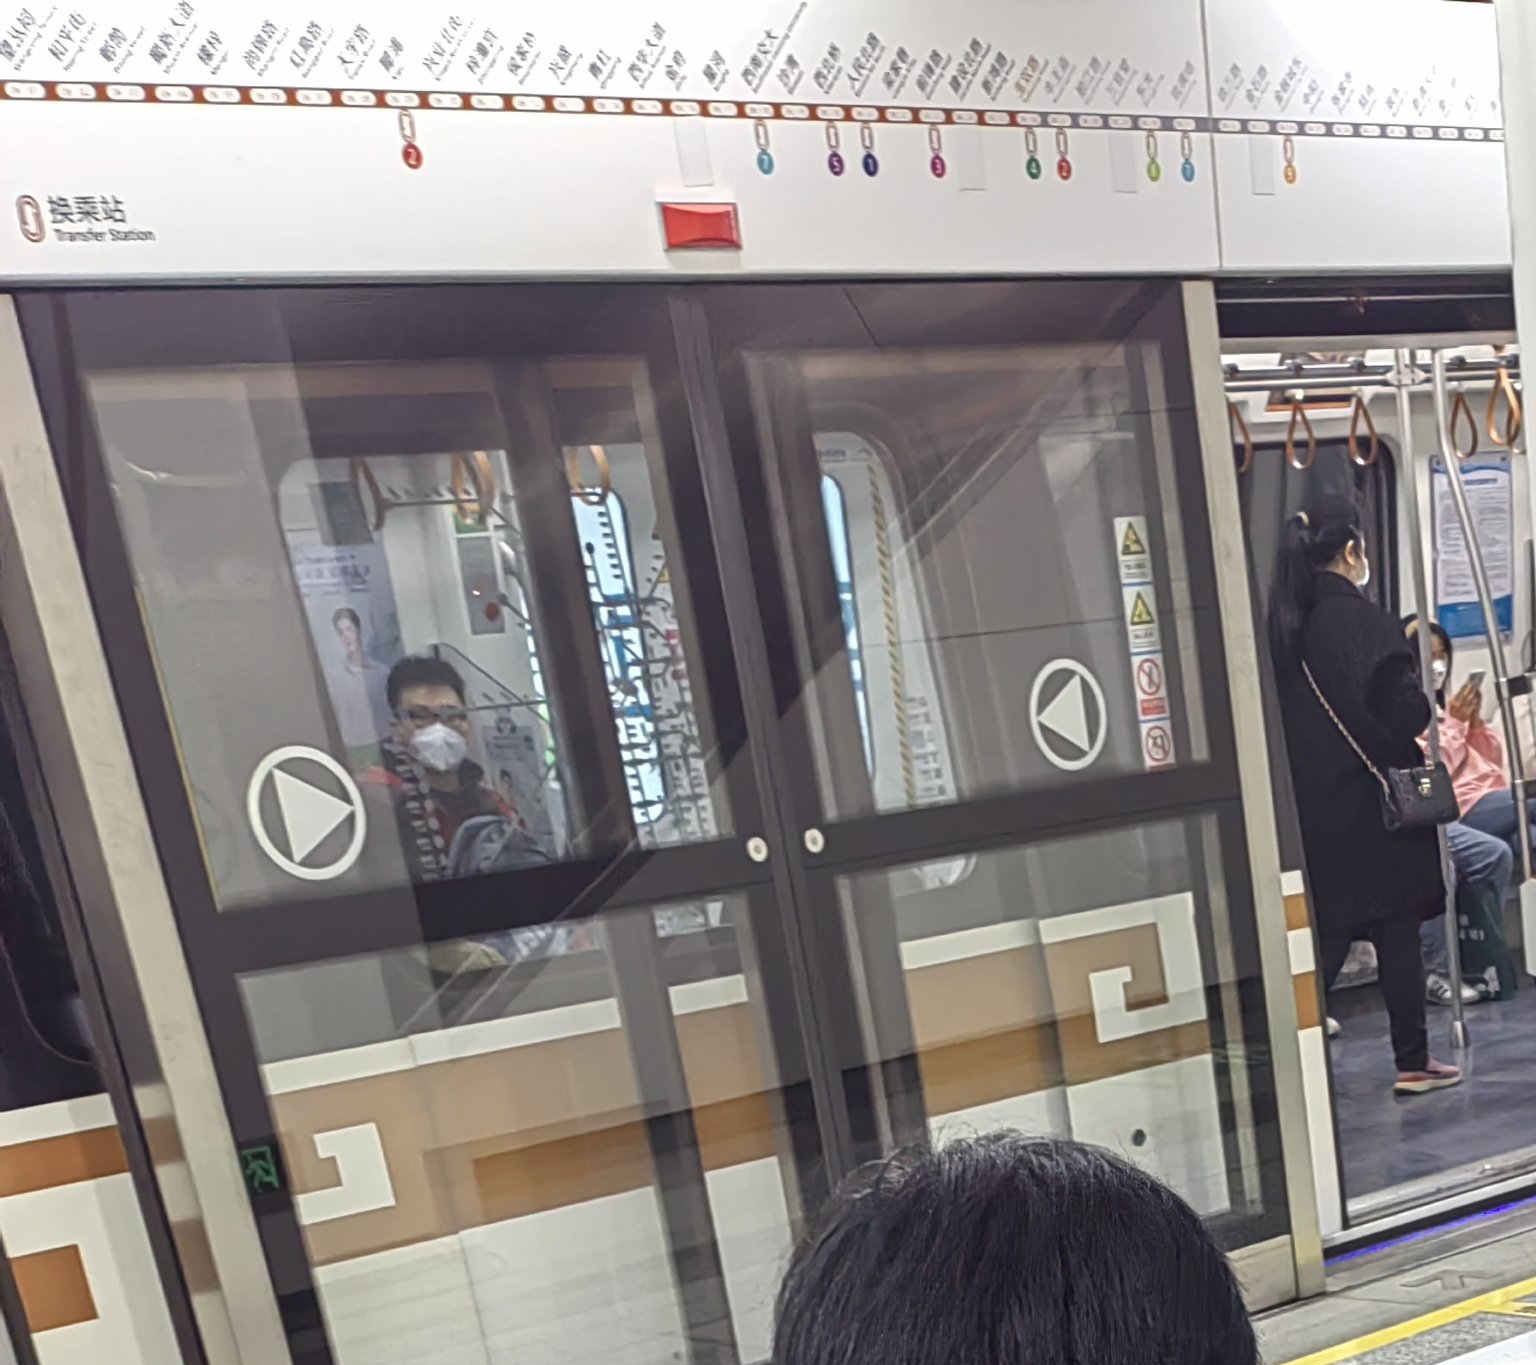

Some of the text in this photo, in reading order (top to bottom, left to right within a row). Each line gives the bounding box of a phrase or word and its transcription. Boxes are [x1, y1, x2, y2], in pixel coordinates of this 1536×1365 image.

[47, 195, 126, 223] 换乘站
[53, 228, 156, 242] Transfer Station
